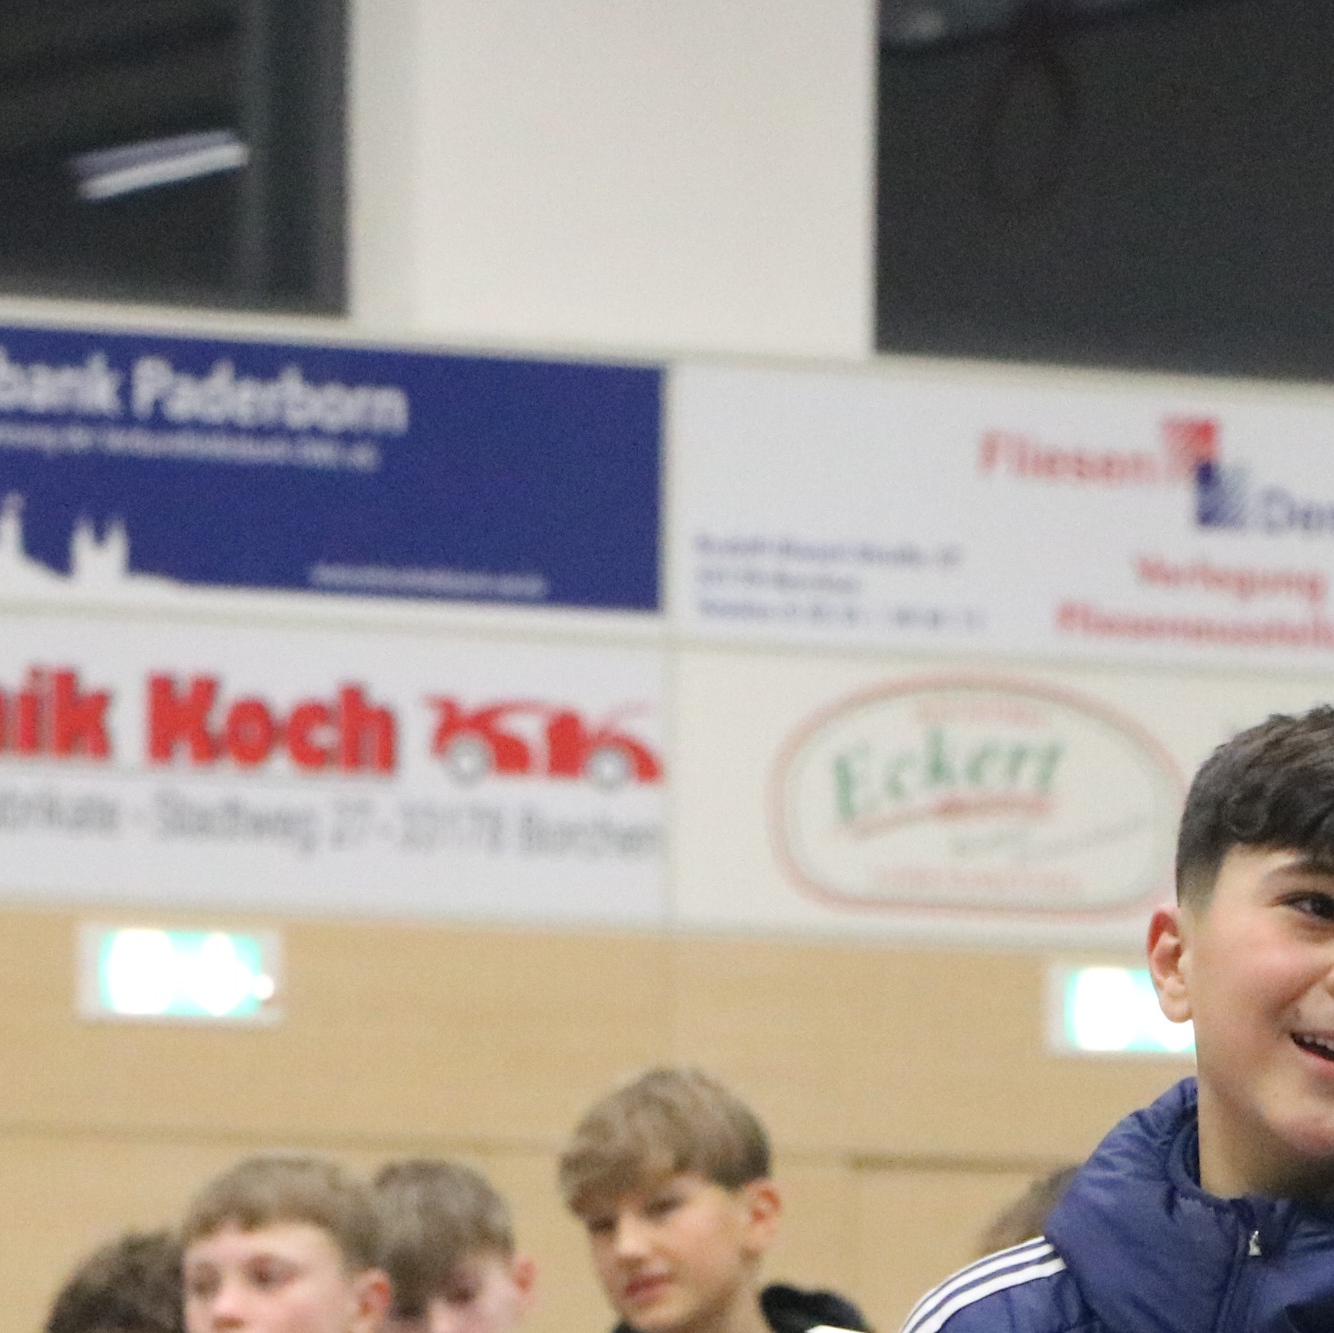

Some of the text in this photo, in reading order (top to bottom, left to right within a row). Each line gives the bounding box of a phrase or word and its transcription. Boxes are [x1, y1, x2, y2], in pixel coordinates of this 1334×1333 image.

[131, 355, 411, 437] Paderborn
[977, 428, 1157, 488] Fliesen
[1133, 550, 1329, 610] Verlegung
[143, 670, 399, 777] Koch
[830, 720, 1065, 823] Eckert
[518, 802, 665, 862] Borchen
